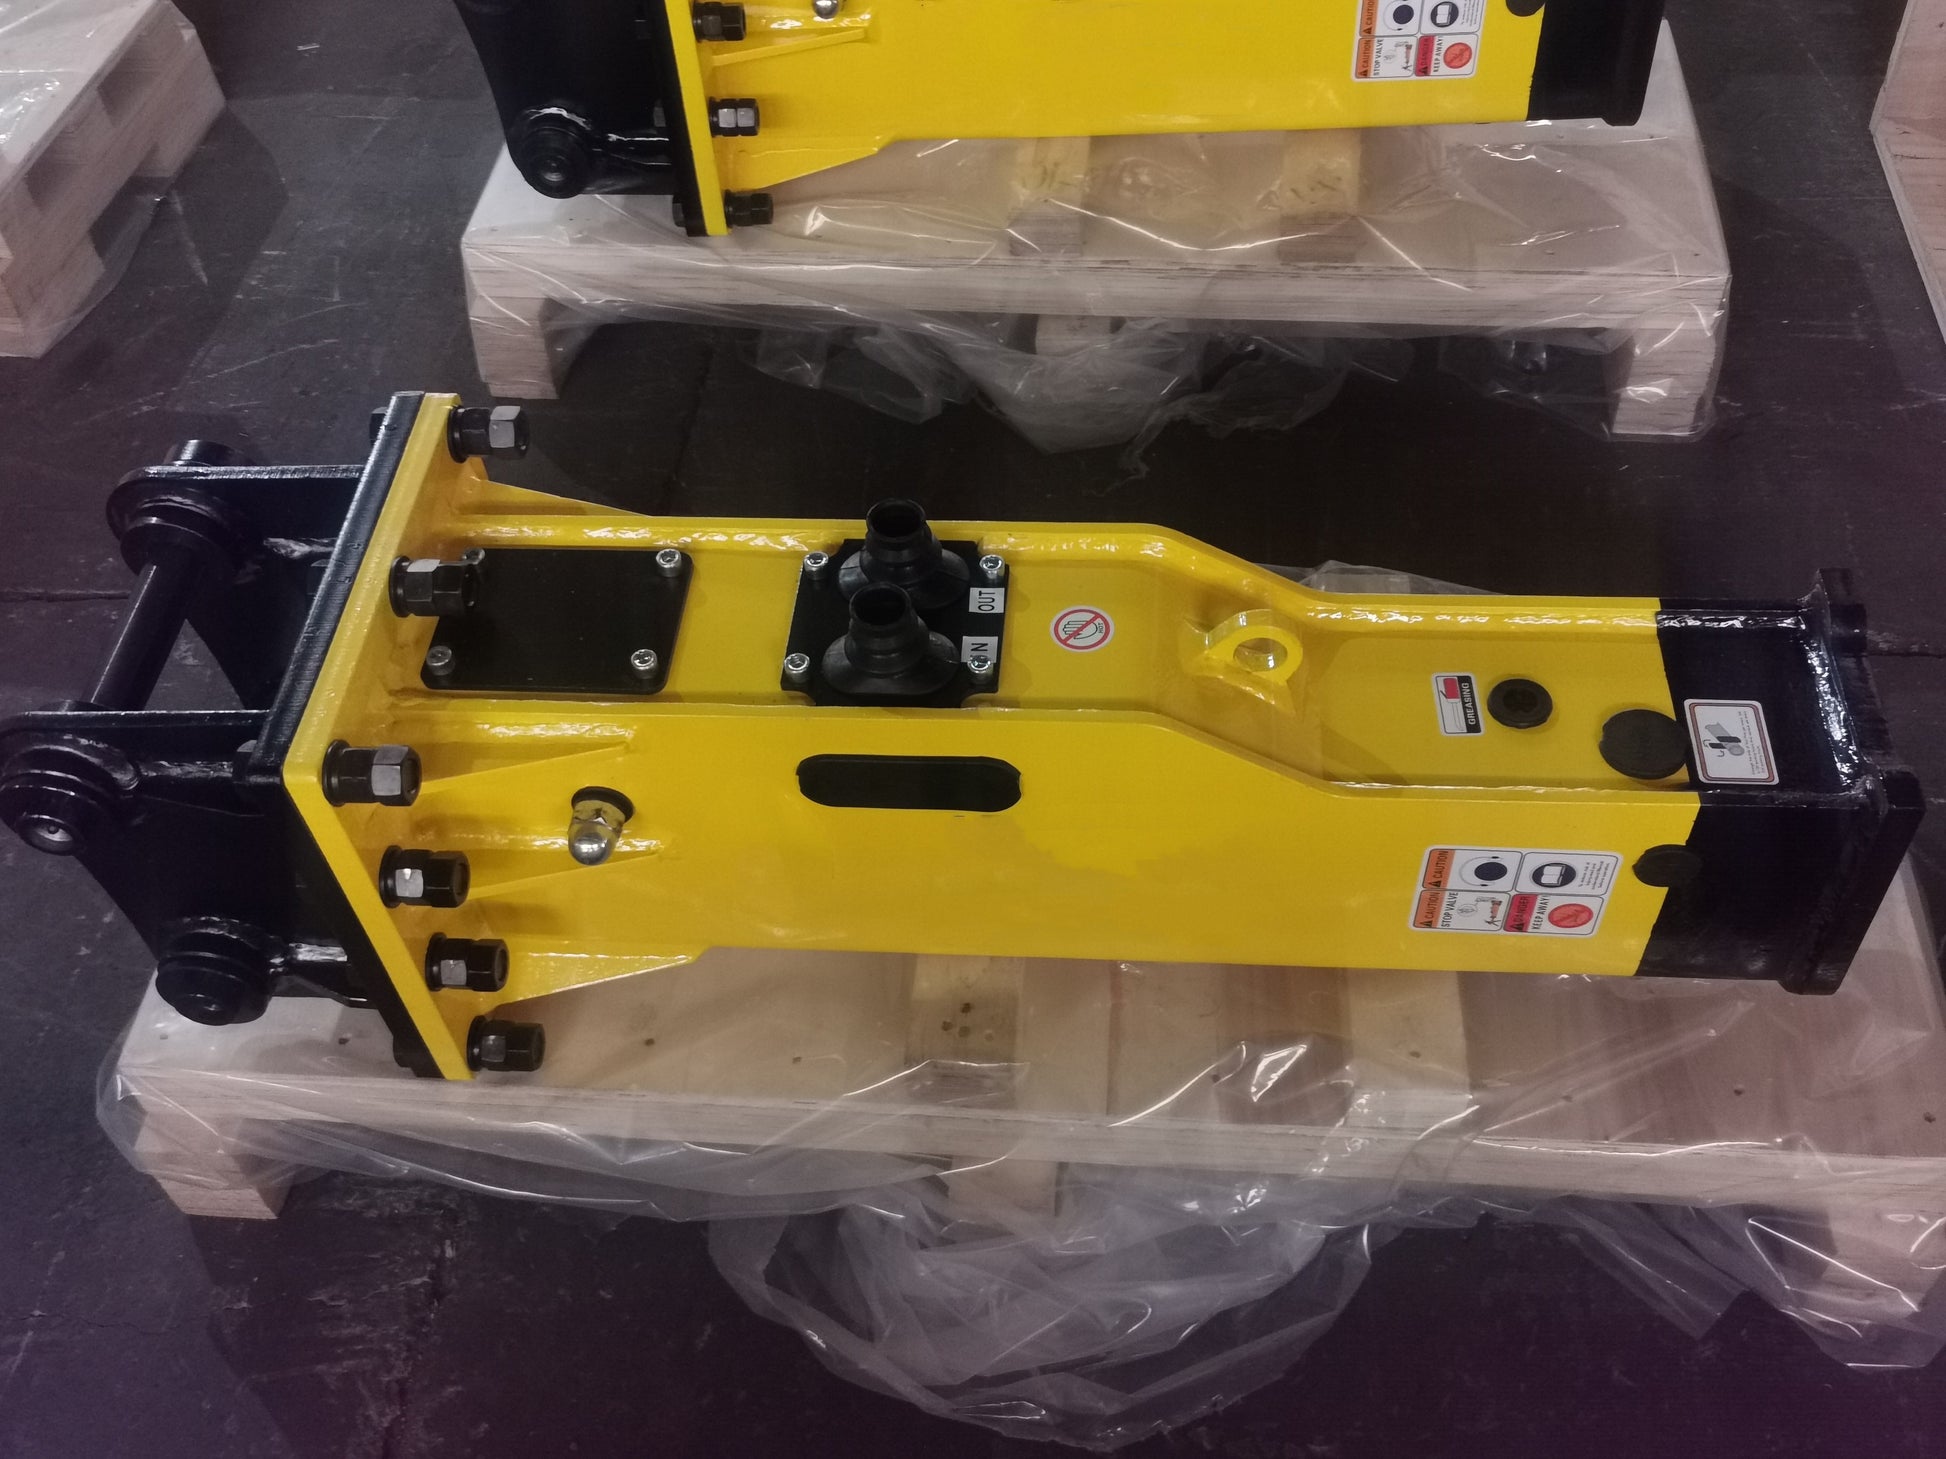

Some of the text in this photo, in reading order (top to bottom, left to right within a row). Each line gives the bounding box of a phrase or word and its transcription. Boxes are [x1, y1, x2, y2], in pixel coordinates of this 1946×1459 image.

[1366, 0, 1375, 26] CAUTIO
[1362, 39, 1373, 68] CAUTION
[1376, 39, 1384, 58] VALVE
[1433, 57, 1441, 72] KEEP
[978, 590, 996, 612] OUT
[1461, 682, 1476, 725] GREASING
[1433, 850, 1449, 879] CAUTION
[1425, 892, 1441, 919] CAUTION
[1441, 892, 1459, 927] STOP VALVE
[1513, 896, 1529, 924] DANGER
[1532, 916, 1543, 930] KEEP
